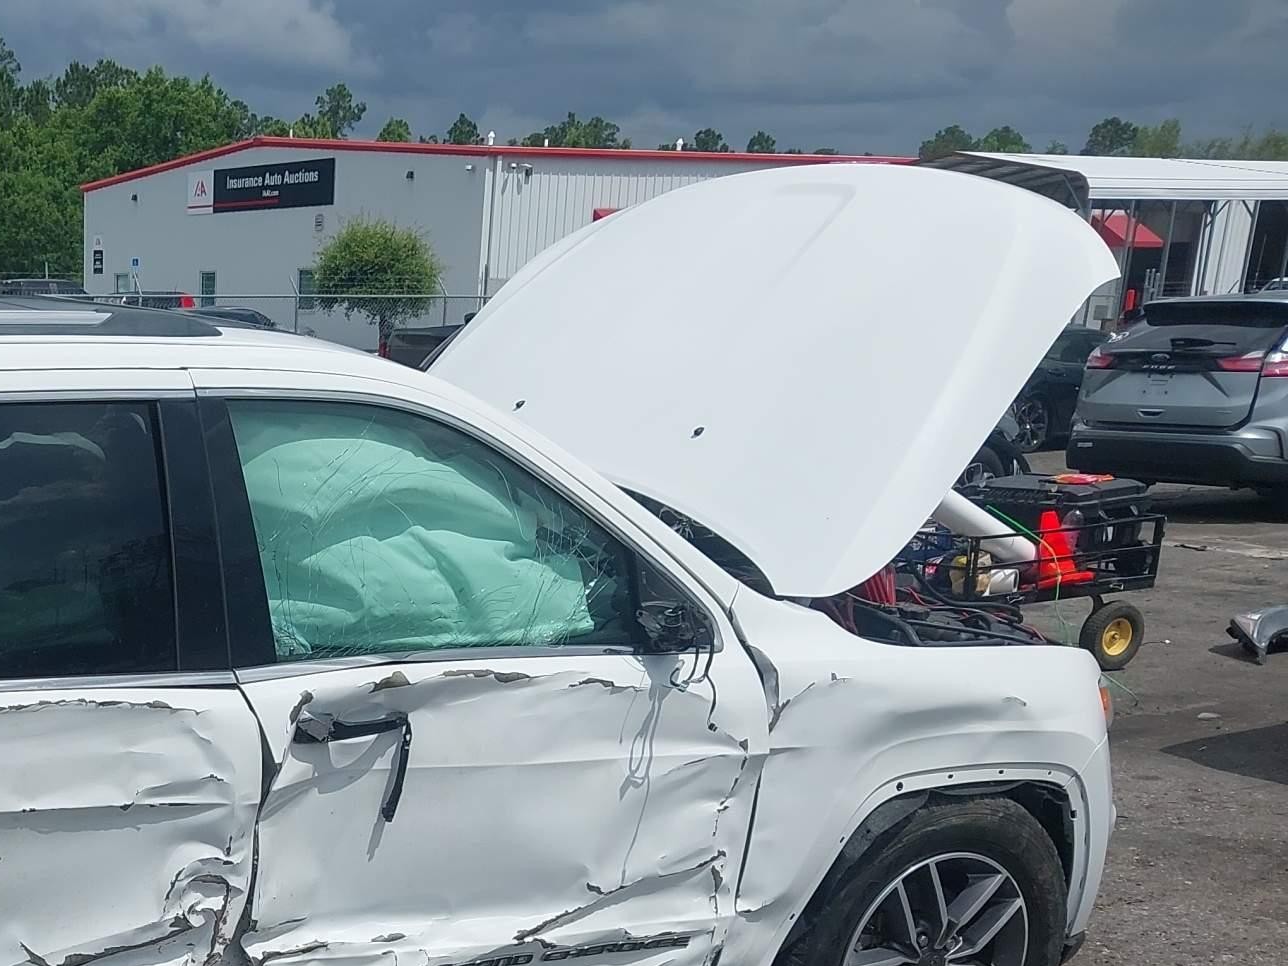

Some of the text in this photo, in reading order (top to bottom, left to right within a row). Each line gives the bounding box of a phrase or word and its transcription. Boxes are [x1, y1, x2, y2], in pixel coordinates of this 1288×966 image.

[226, 168, 319, 190] Insurance Auto Auctions
